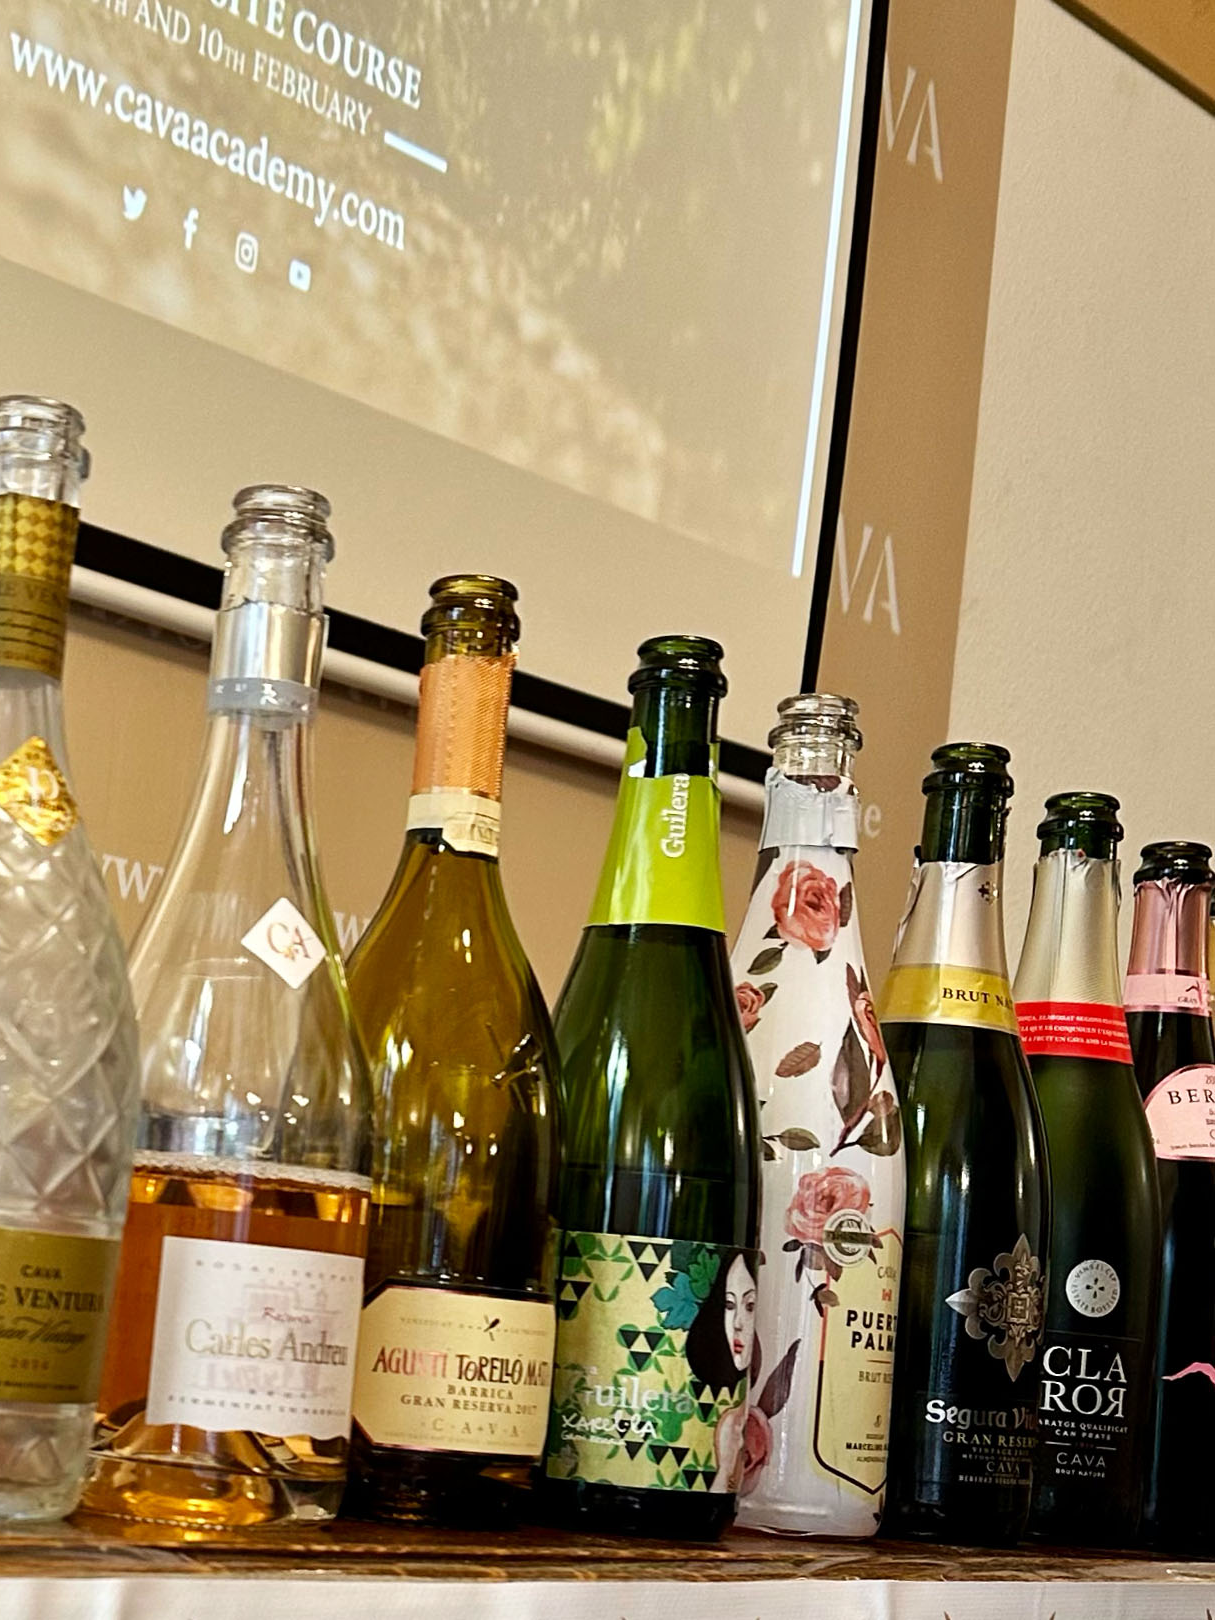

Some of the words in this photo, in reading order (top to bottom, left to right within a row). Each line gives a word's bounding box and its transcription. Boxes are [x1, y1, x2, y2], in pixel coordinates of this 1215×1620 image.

[133, 0, 191, 45] AND
[197, 23, 246, 76] 10TH
[252, 50, 373, 136] FEBRUARY
[292, 12, 422, 109] COURSE
[10, 32, 406, 250] www.cavaacademy.com
[660, 773, 690, 858] Guilera
[942, 988, 990, 1005] BRUT
[185, 1318, 272, 1360] Carles
[1043, 1345, 1127, 1383] CLA
[400, 1394, 445, 1409] GRAN
[452, 1398, 512, 1415] RESERVA
[447, 1383, 514, 1401] BARRICA
[925, 1400, 1007, 1430] Segura
[943, 1431, 992, 1444] GRAN
[1055, 1429, 1076, 1437] CAN
[986, 1461, 1021, 1475] CAVA
[1056, 1452, 1106, 1467] CAVA
